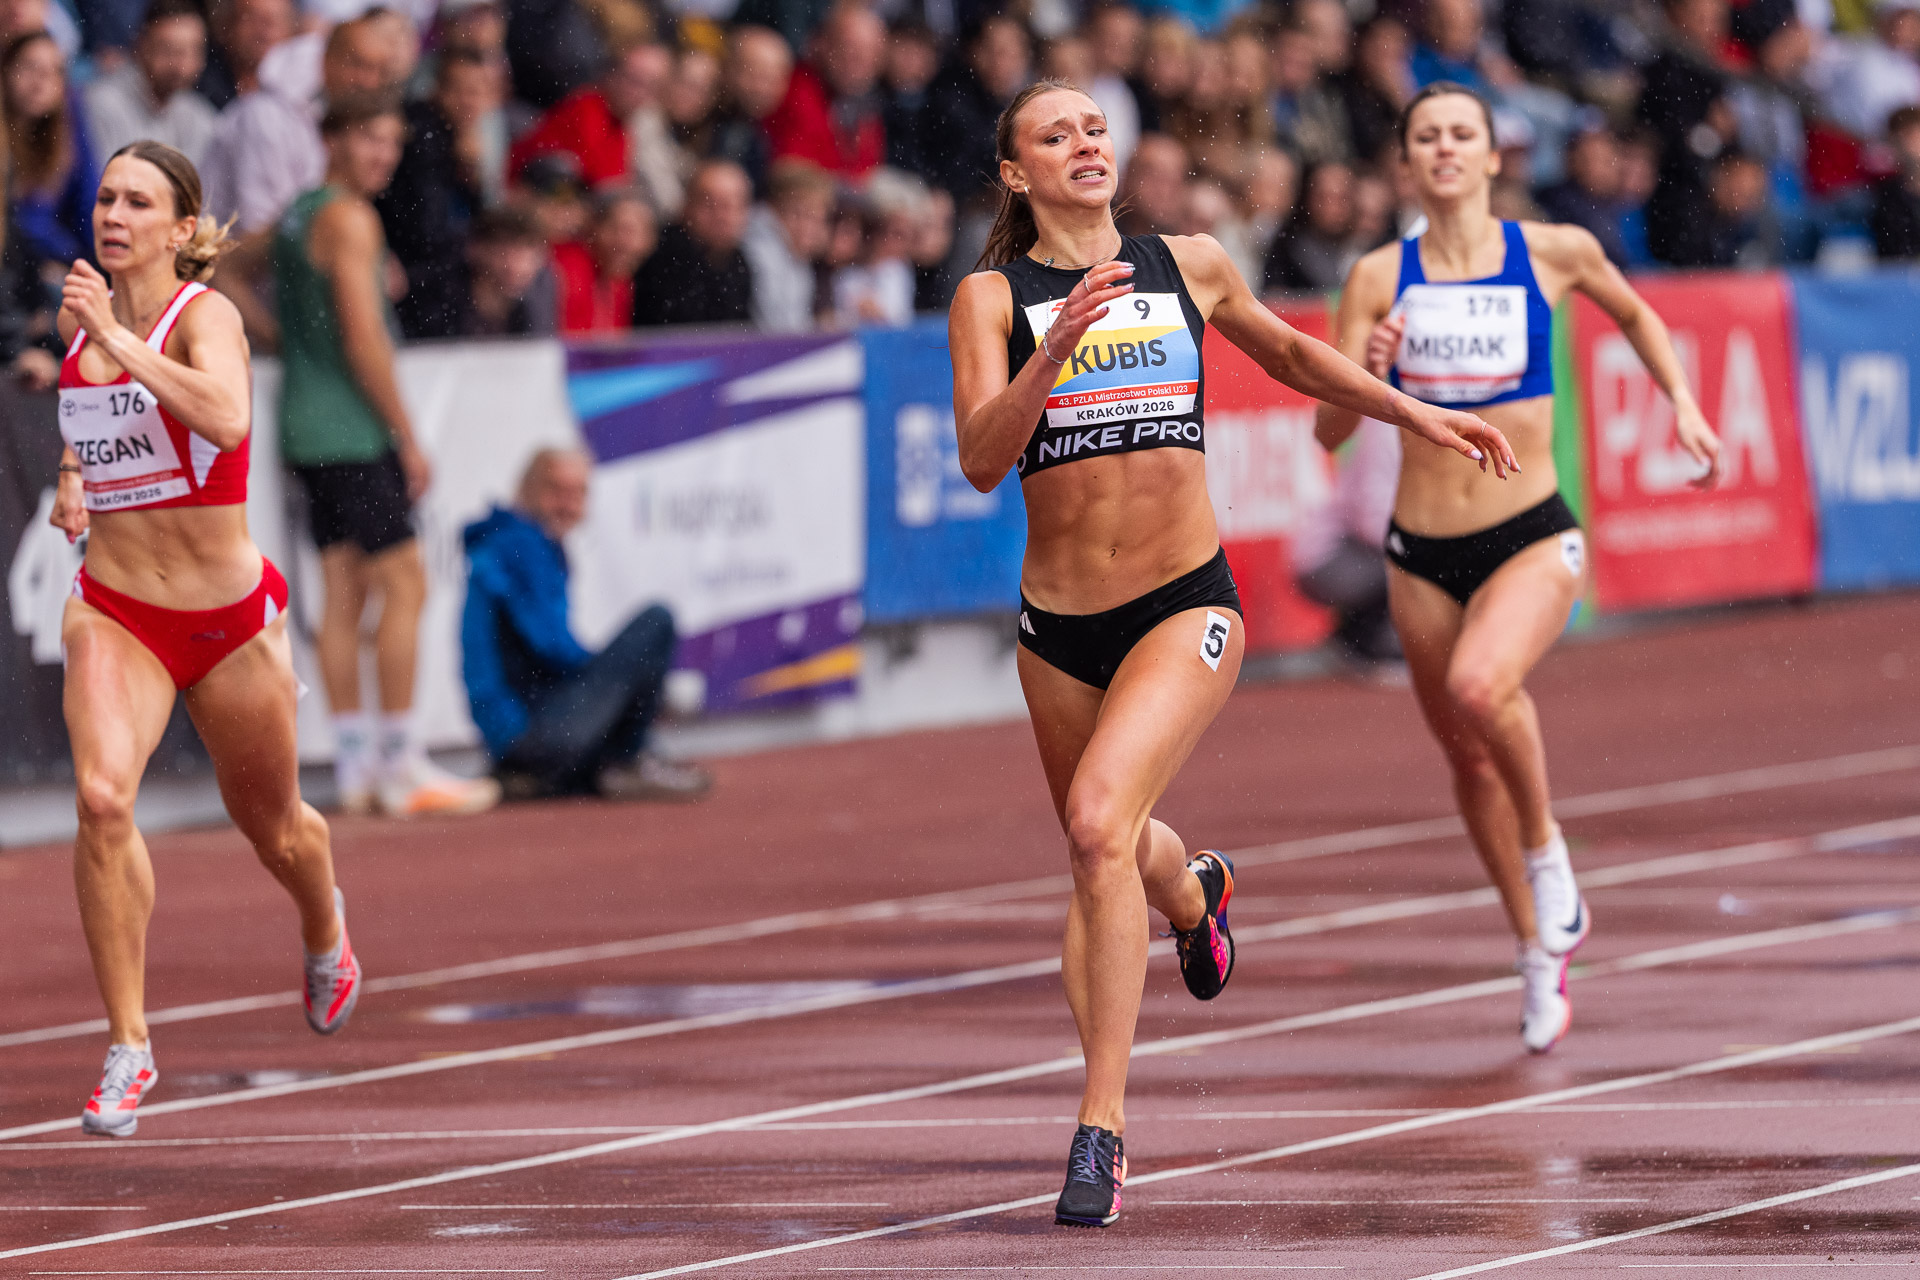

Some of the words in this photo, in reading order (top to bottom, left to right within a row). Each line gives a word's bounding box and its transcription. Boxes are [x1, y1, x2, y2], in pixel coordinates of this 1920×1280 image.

[1133, 299, 1151, 320] 9
[1467, 296, 1511, 317] 178
[1071, 339, 1167, 376] KUBIS
[1406, 335, 1505, 360] MISIAK
[109, 391, 145, 416] 176
[1058, 398, 1072, 406] 43.
[1073, 396, 1094, 405] PZLA
[1095, 390, 1146, 402] Mistrzostwa
[1148, 386, 1172, 396] Polski
[1173, 384, 1188, 394] U23
[1076, 402, 1139, 421] KRAKÓW
[1142, 400, 1175, 414] 2026
[1038, 424, 1126, 463] NIKE
[1132, 420, 1201, 444] PRO
[1204, 622, 1226, 659] 5
